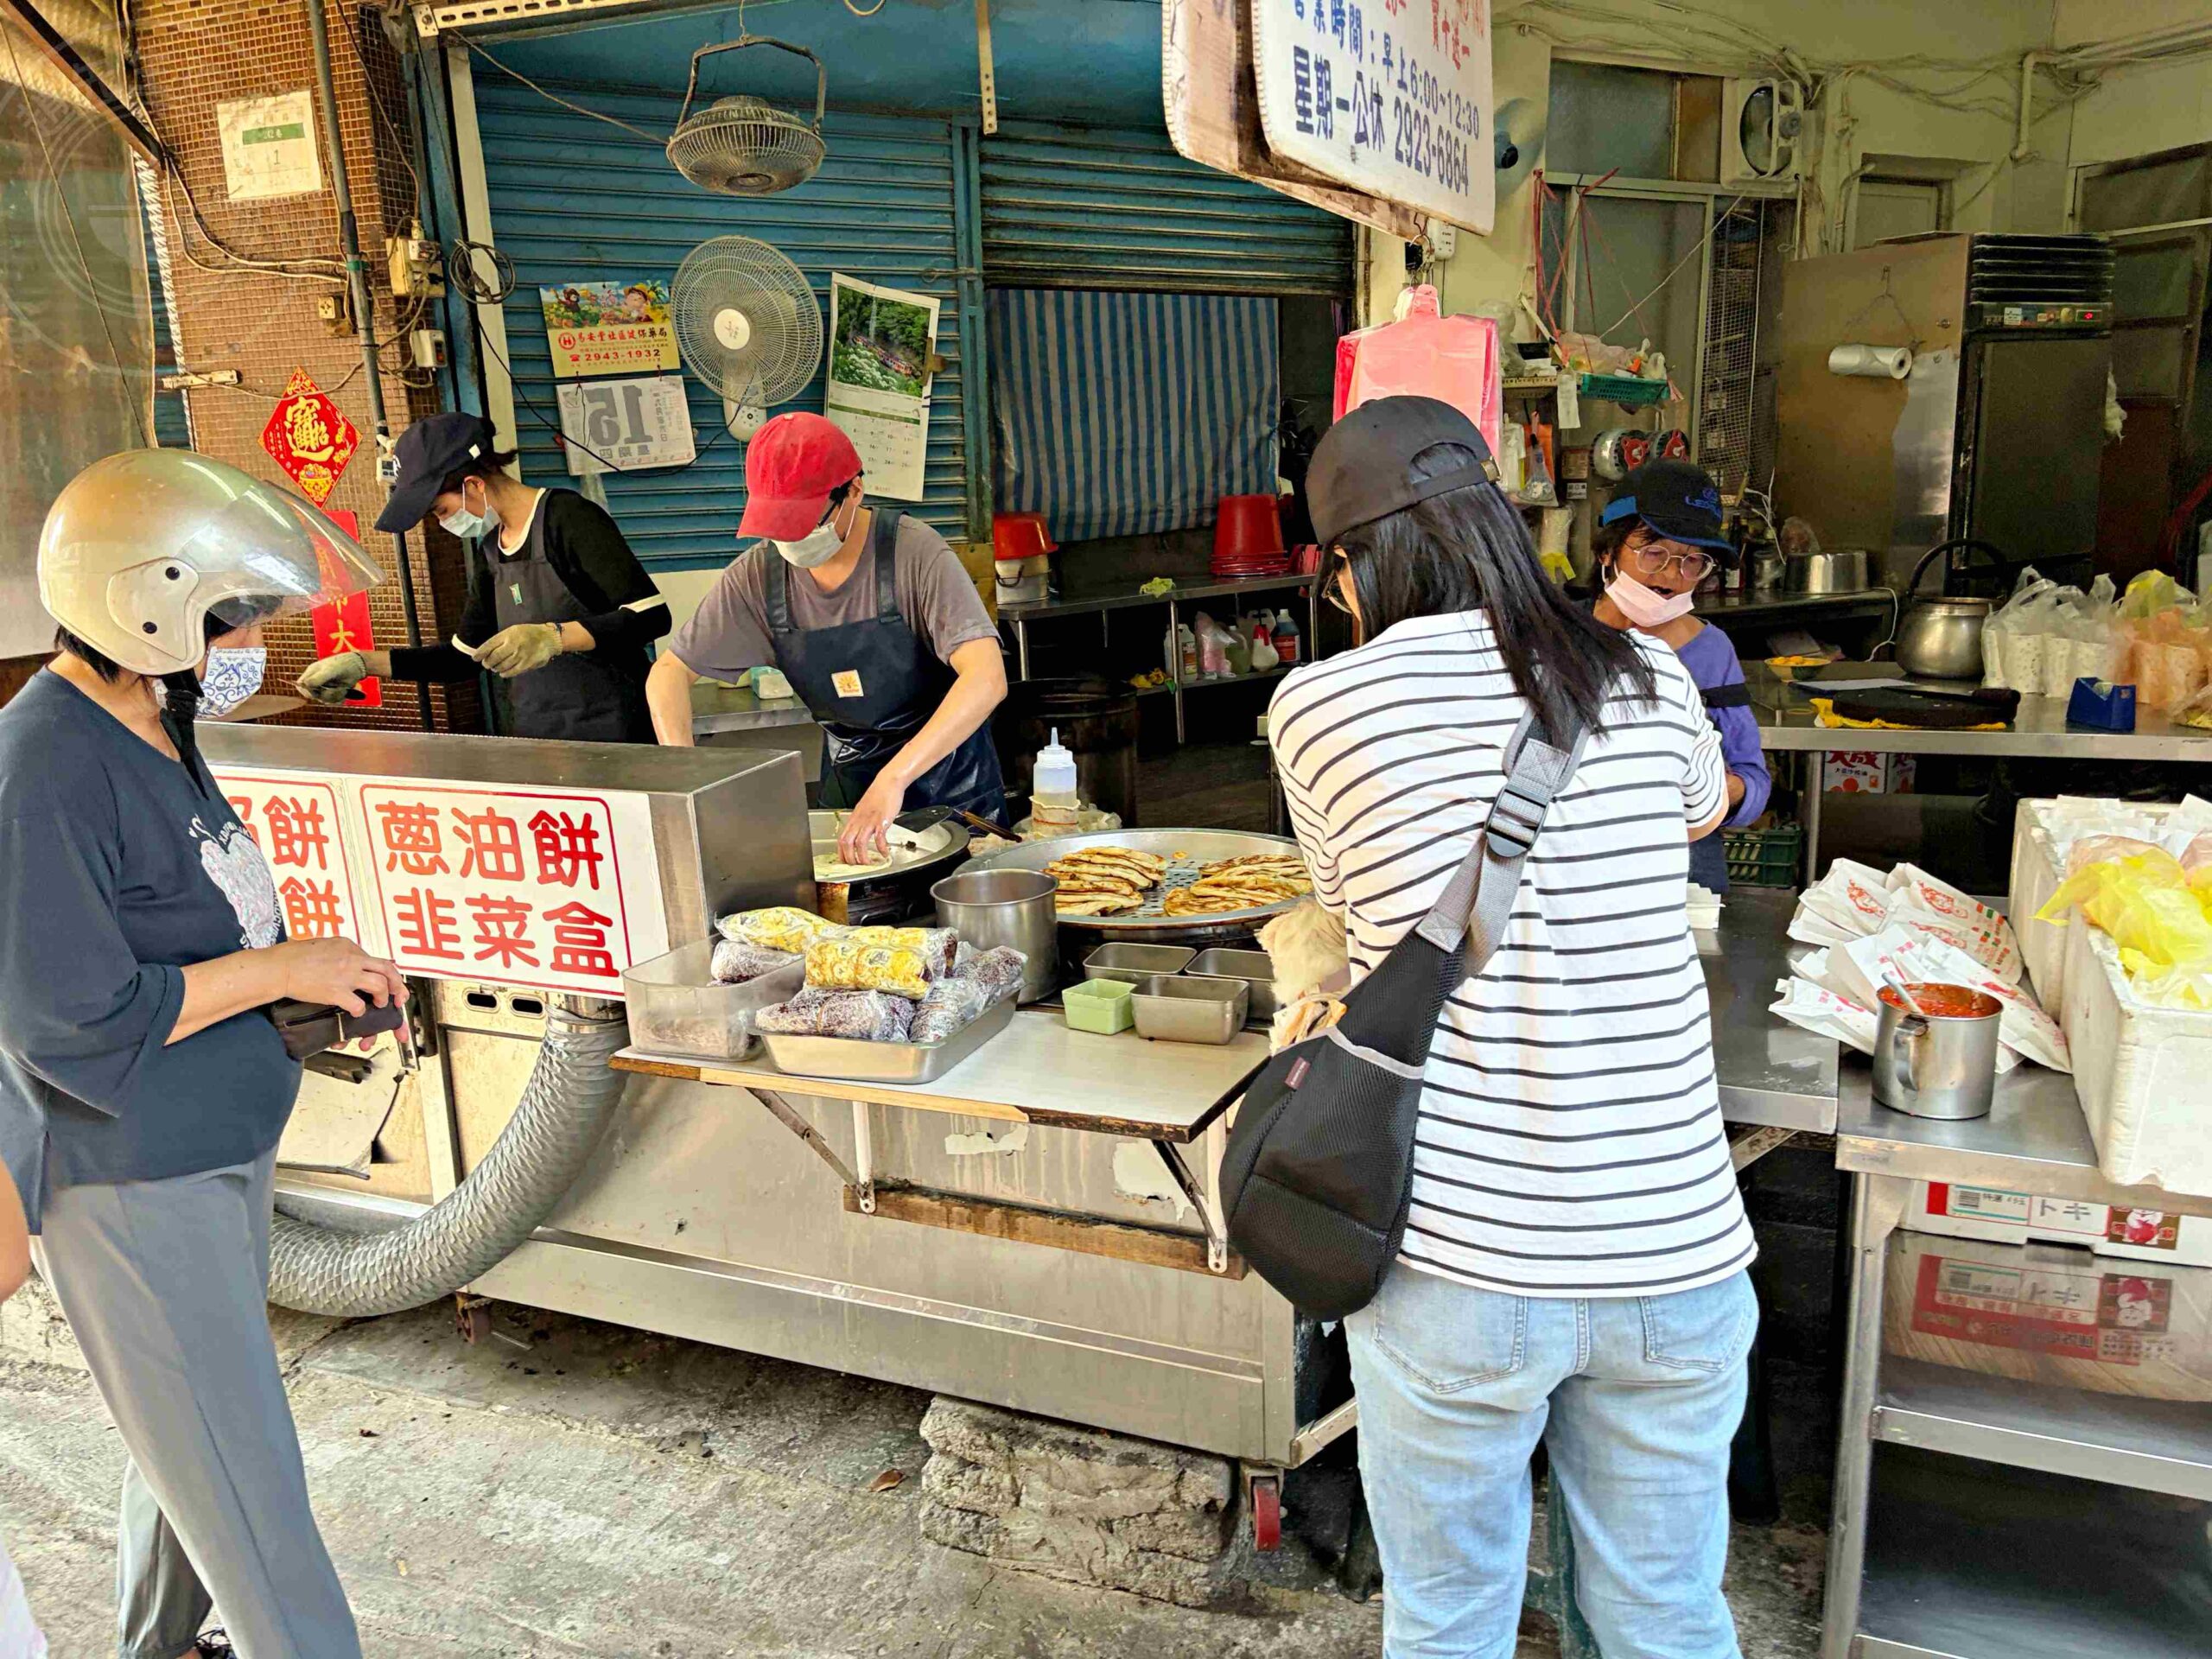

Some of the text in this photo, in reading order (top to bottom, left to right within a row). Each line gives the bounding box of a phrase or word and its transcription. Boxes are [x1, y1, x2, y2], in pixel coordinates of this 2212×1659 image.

[1294, 45, 1469, 197] 星期一公休 2923-6864
[585, 348, 661, 361] 2943-1932
[375, 800, 604, 891] 蔥油餅
[279, 875, 345, 940] 餅
[392, 887, 620, 979] 韭菜盒
